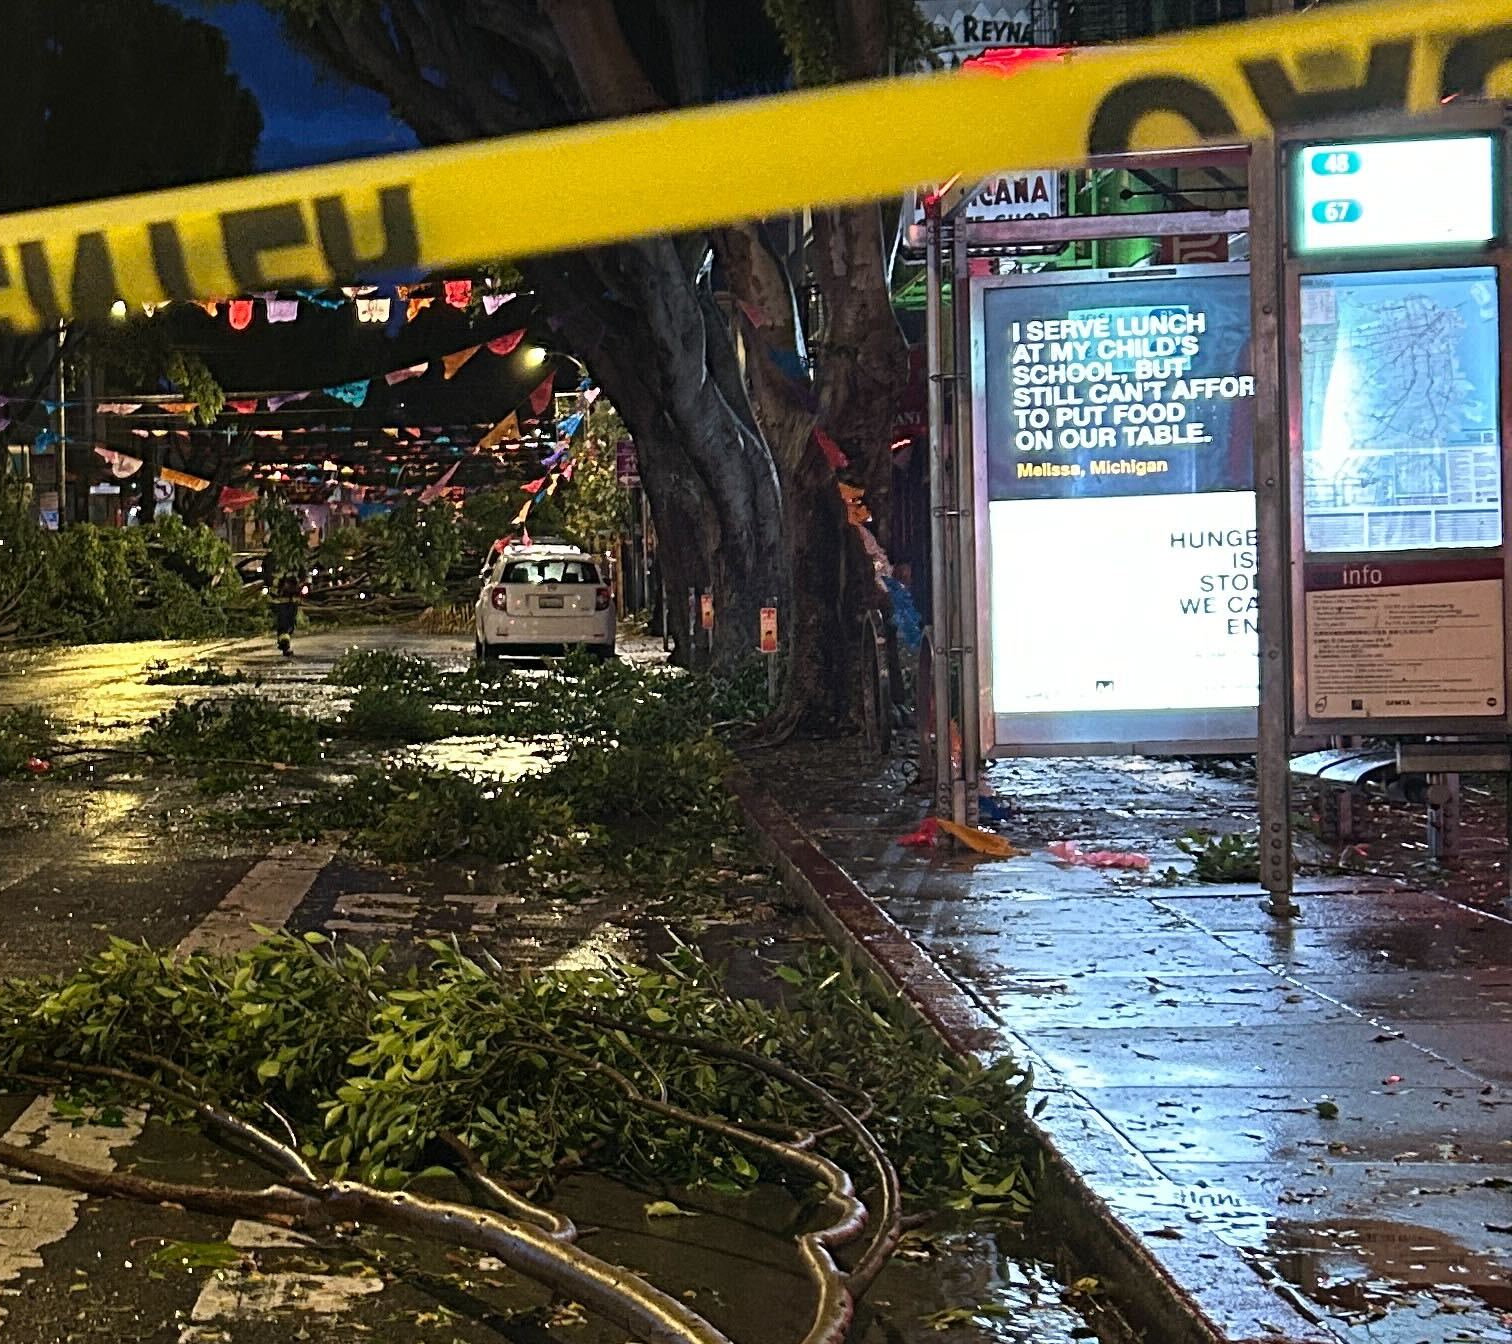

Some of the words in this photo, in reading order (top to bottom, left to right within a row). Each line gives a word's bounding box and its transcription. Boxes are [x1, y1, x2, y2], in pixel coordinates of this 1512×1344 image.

[963, 15, 1033, 43] REYNA
[1324, 202, 1350, 221] 67
[1012, 322, 1021, 343] I
[1026, 318, 1111, 342] SERVE
[1117, 312, 1207, 337] LUNCH
[1012, 343, 1044, 365] AT
[1050, 341, 1095, 362] MY
[1097, 336, 1200, 358] CHILD'S
[1013, 362, 1128, 385] SCHOOL,
[1135, 358, 1188, 381] BUT
[1013, 384, 1084, 408] STILL
[1088, 381, 1167, 404] CAN'T
[1013, 408, 1050, 429] TO
[1056, 406, 1107, 428] PUT
[1113, 402, 1187, 425] FOOD
[1015, 429, 1054, 452] ON
[1059, 427, 1117, 449] OUR
[1122, 423, 1213, 447] TABLE.
[1016, 462, 1086, 479] Melissa,
[1090, 459, 1169, 476] Michigan
[1233, 551, 1255, 569] IS
[1343, 564, 1383, 585] info
[1180, 597, 1217, 615] WE
